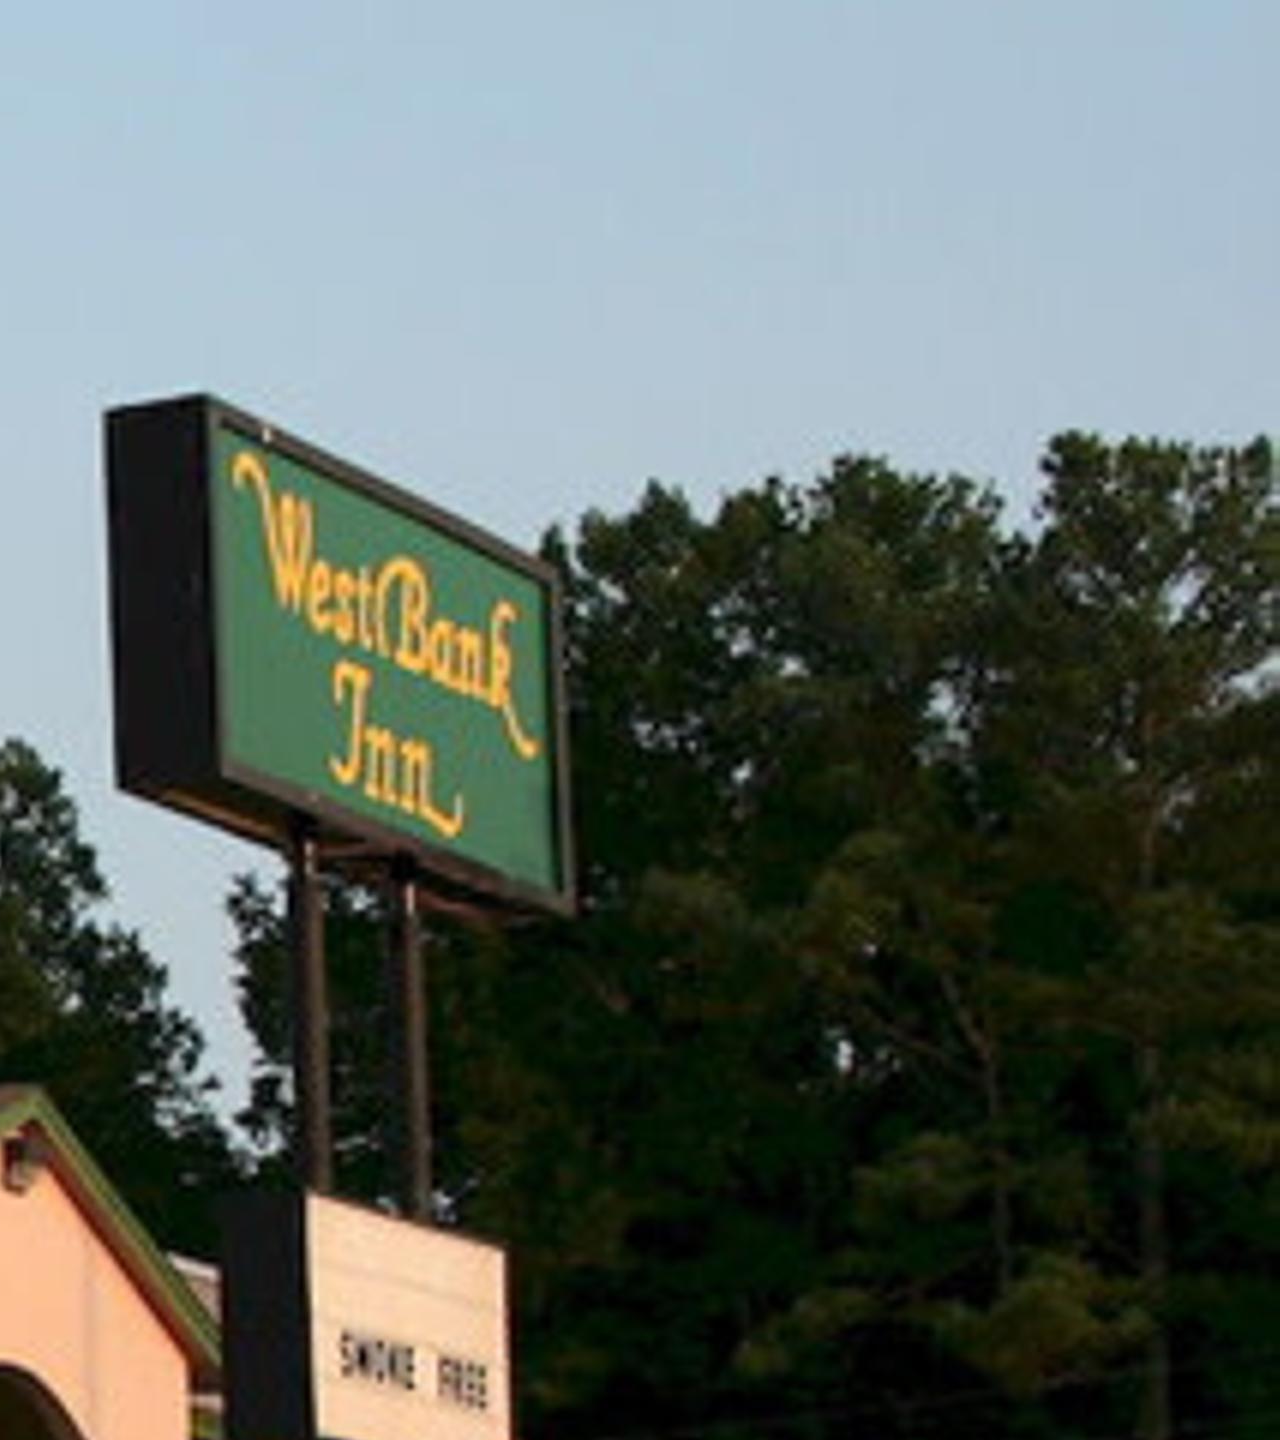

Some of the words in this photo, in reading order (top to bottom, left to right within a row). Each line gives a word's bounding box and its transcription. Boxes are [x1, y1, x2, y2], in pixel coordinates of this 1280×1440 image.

[230, 451, 375, 651] West
[375, 557, 539, 758] Bank
[330, 660, 464, 837] Inn
[340, 1330, 416, 1390] SMOKE
[438, 1355, 489, 1410] FREE
